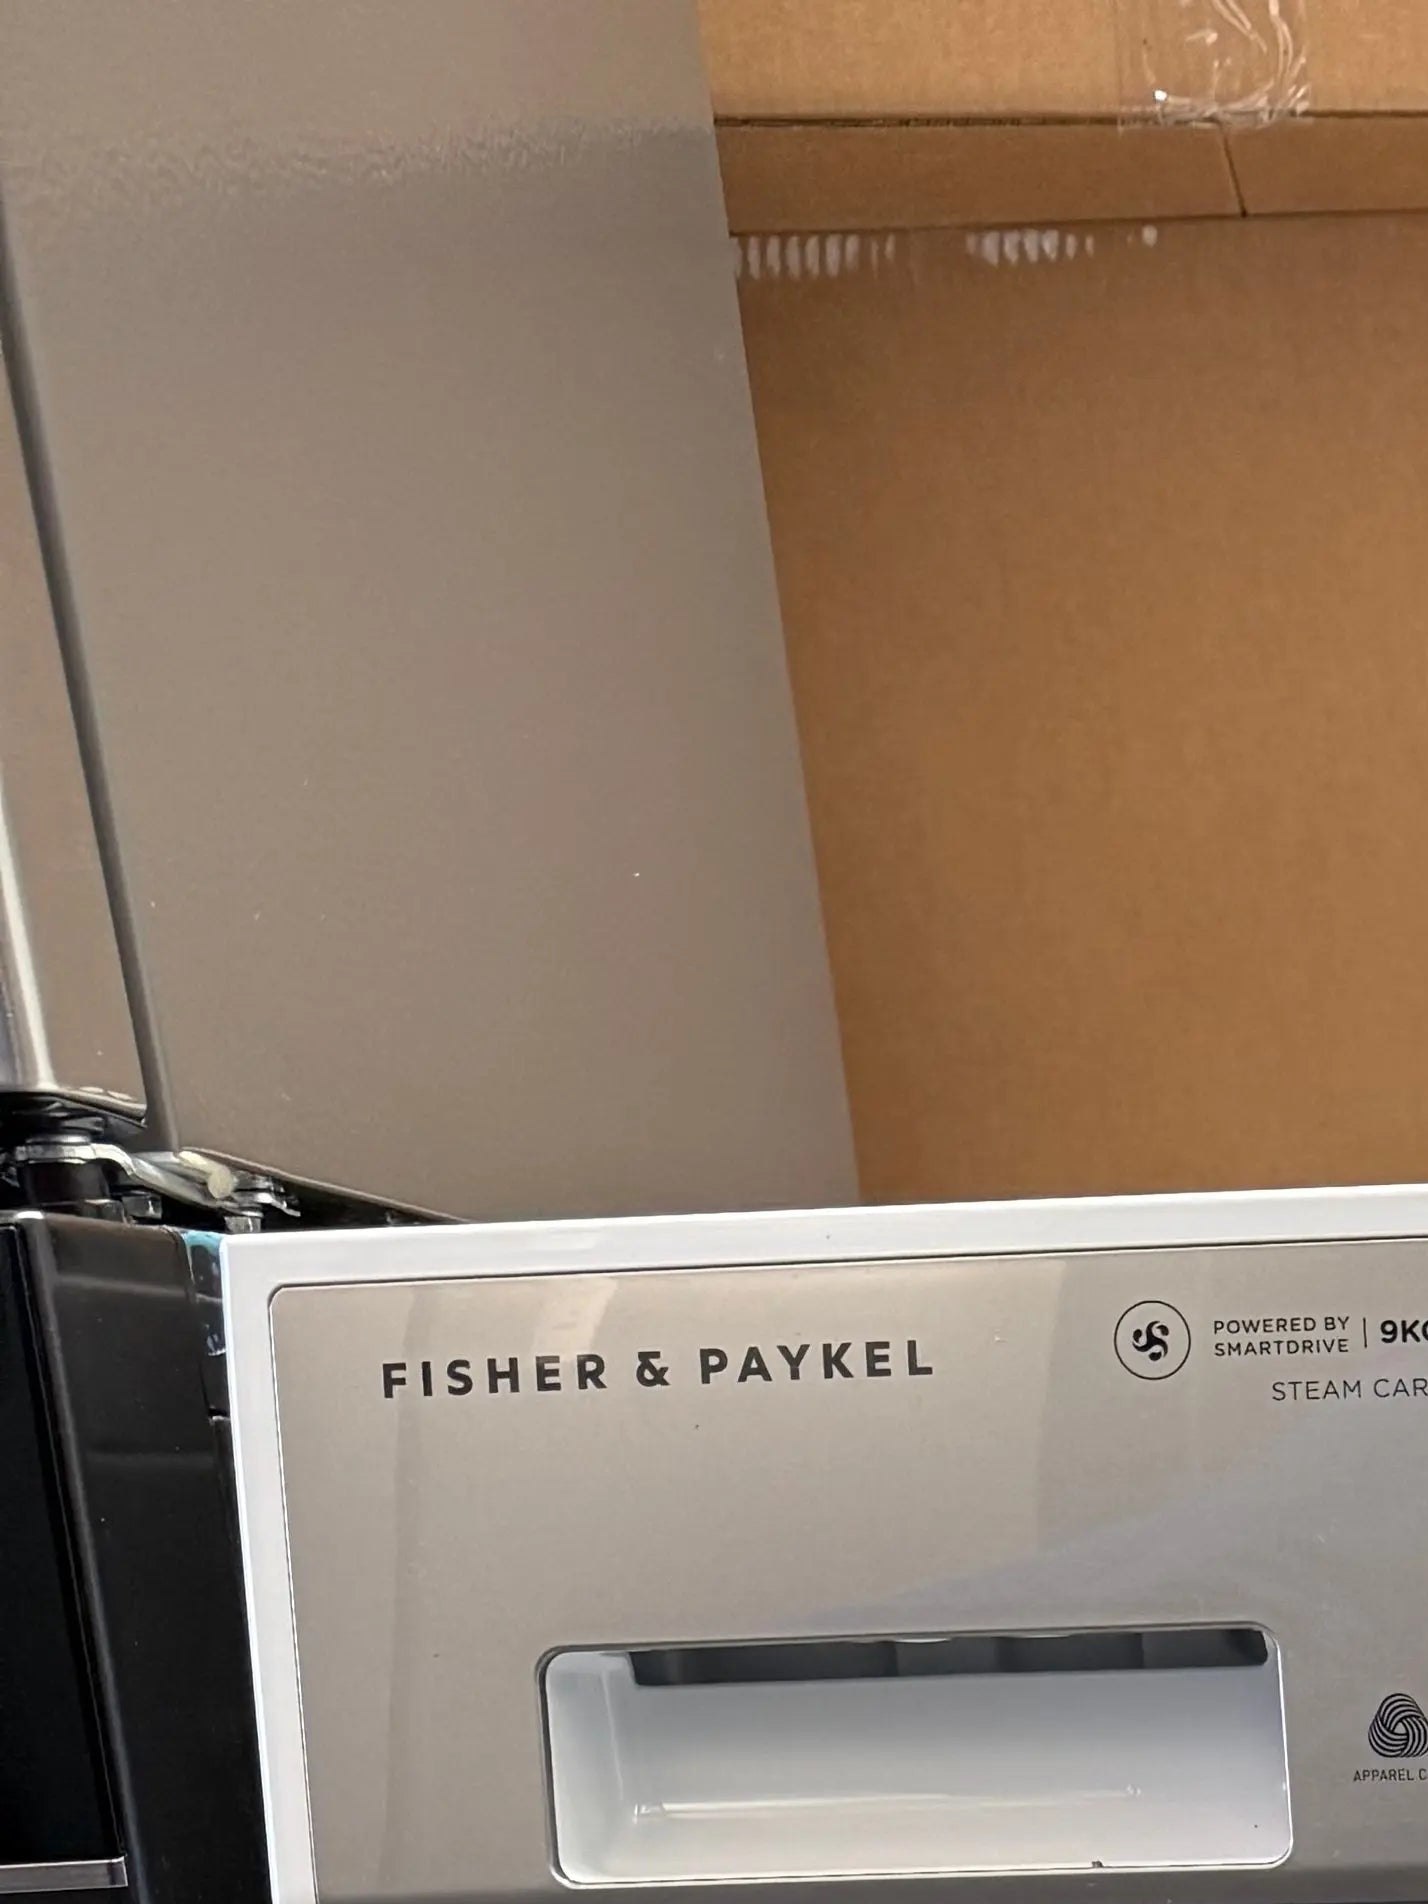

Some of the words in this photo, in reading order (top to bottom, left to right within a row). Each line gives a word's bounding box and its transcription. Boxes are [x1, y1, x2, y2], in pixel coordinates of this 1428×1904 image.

[1213, 1317, 1316, 1335] POWERED
[1325, 1316, 1349, 1332] BY
[1215, 1339, 1348, 1356] SMARTDRIVE
[383, 1354, 606, 1398] FISHER
[636, 1351, 669, 1387] &
[700, 1340, 932, 1384] PAYKEL
[1273, 1380, 1361, 1401] STEAM
[1354, 1768, 1414, 1781] APPAREL
